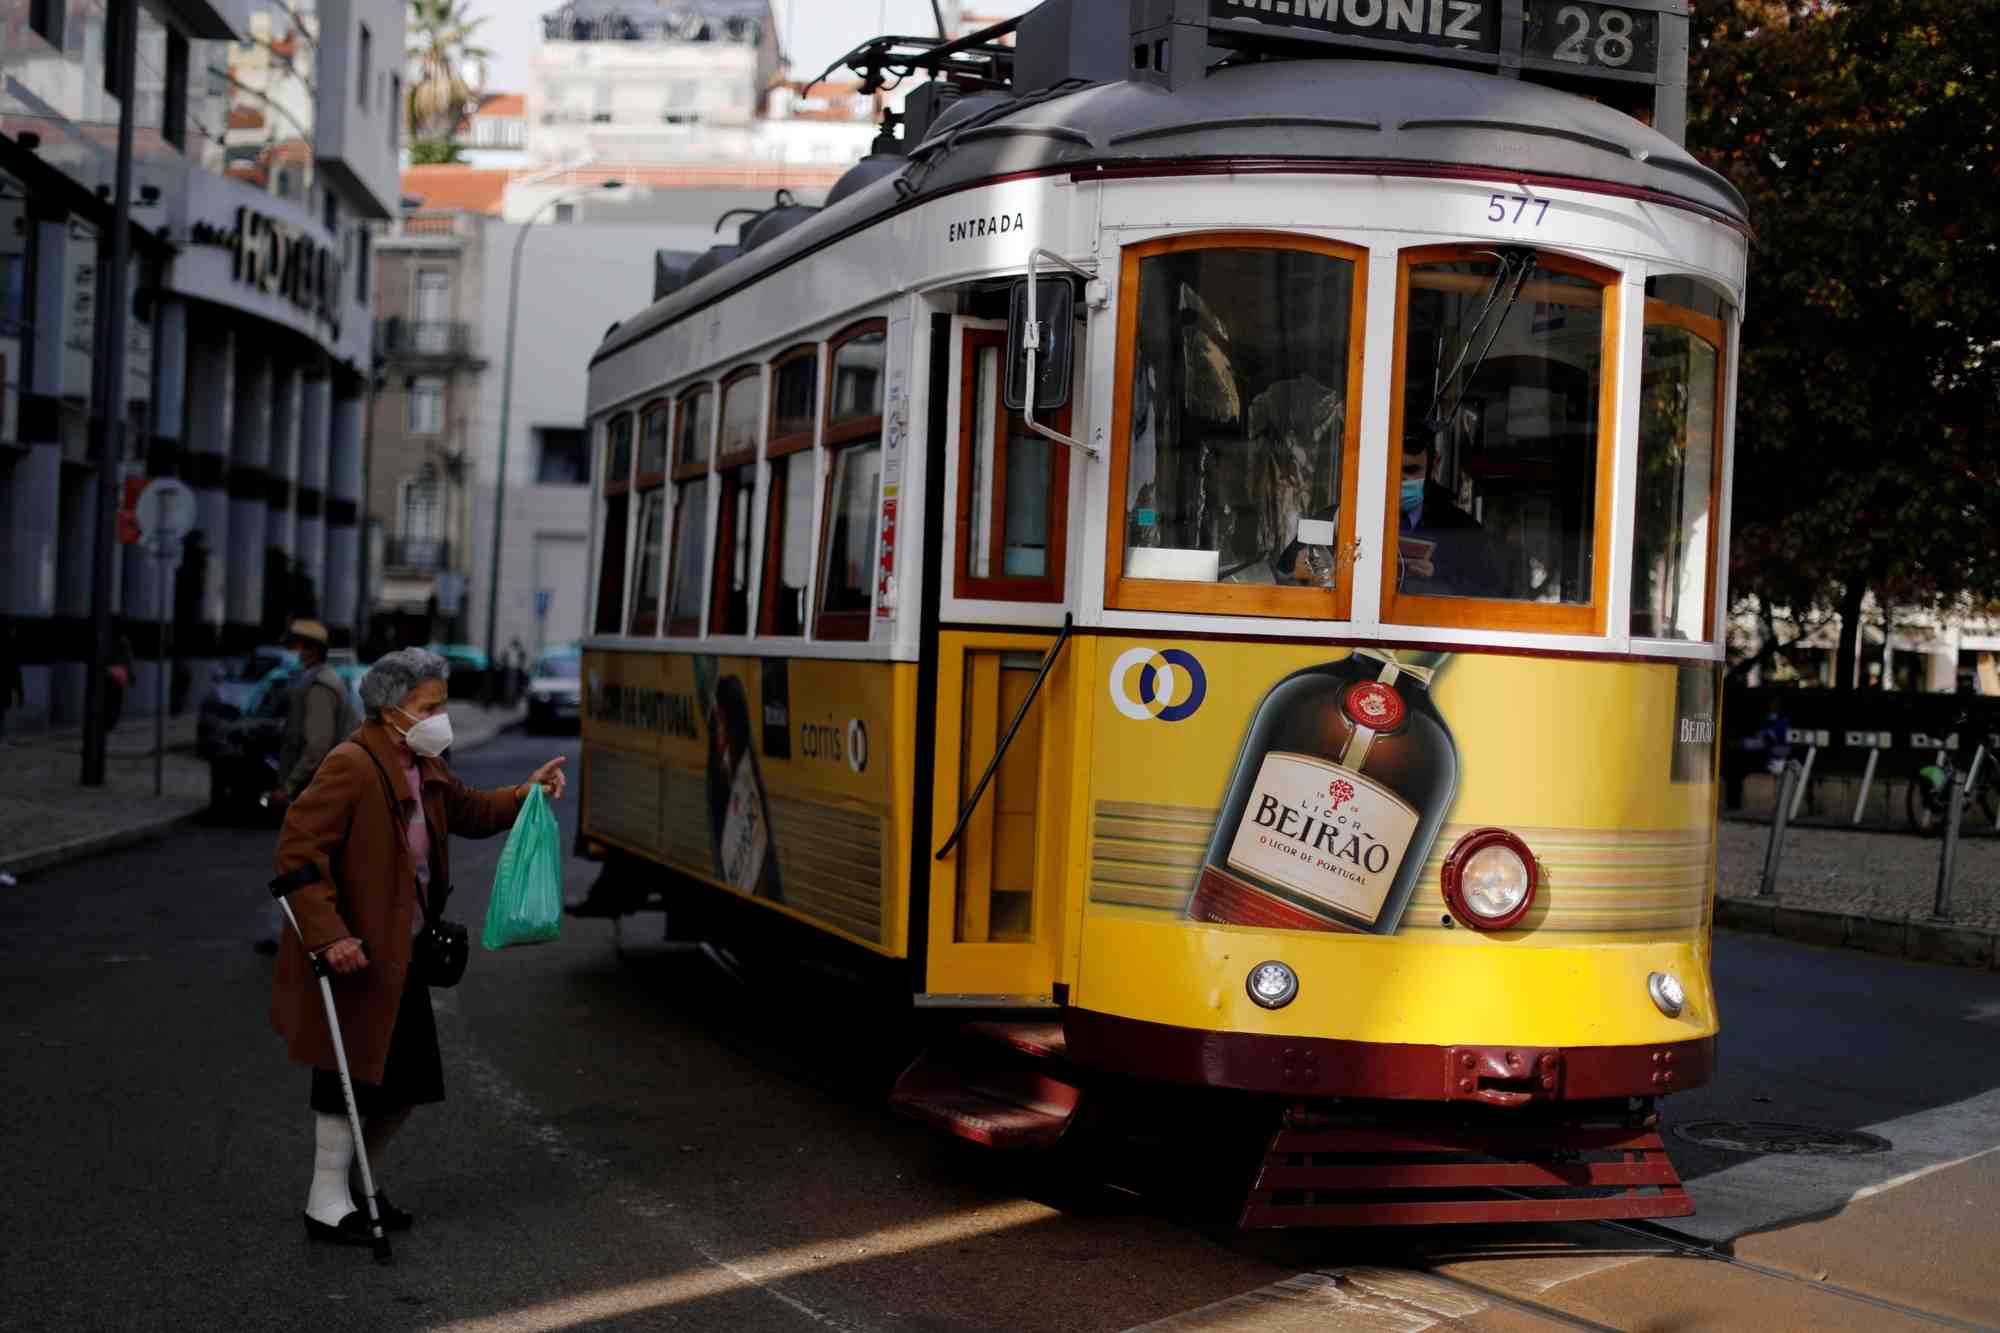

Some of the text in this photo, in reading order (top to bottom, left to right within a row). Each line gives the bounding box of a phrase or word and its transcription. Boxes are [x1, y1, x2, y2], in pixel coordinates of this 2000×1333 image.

[1226, 0, 1482, 41] .MONIZ
[1551, 5, 1634, 67] 28
[948, 212, 1024, 243] ENTRADA
[1487, 193, 1551, 227] 577
[1252, 793, 1391, 874] BEIRÃO
[1300, 799, 1362, 831] LICOR
[1268, 838, 1298, 857] LICOR
[1299, 852, 1314, 865] DE
[1316, 857, 1368, 886] PORTUGAL
